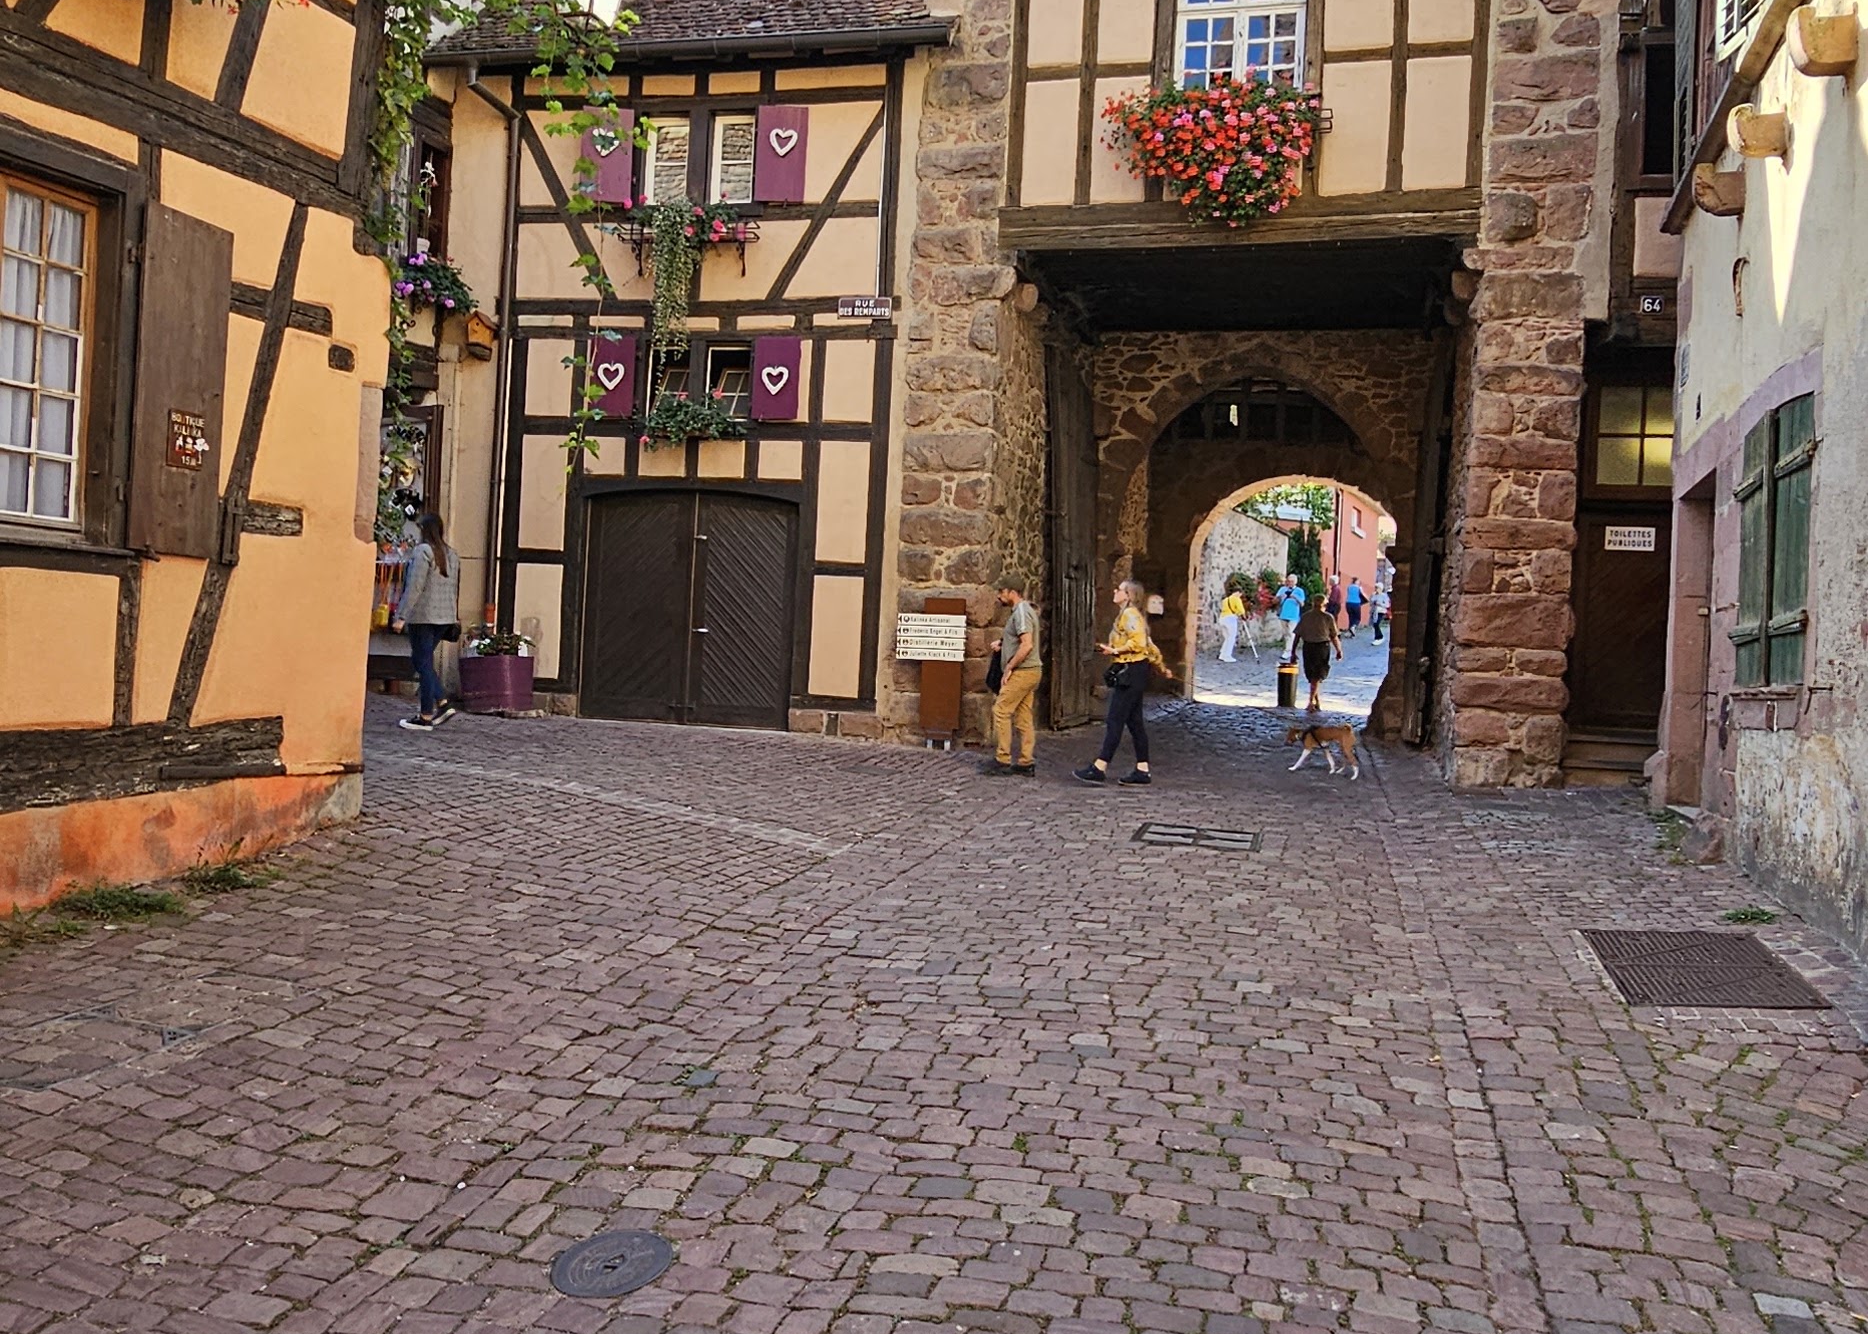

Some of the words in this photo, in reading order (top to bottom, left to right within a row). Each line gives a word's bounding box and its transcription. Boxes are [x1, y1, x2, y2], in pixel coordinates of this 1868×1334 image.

[855, 299, 875, 307] RUE
[1644, 298, 1660, 312] 64
[839, 307, 853, 316] DES
[854, 307, 890, 316] REMPARTS
[1609, 530, 1652, 538] TOILETTES
[1607, 539, 1653, 547] PUBLIQUES
